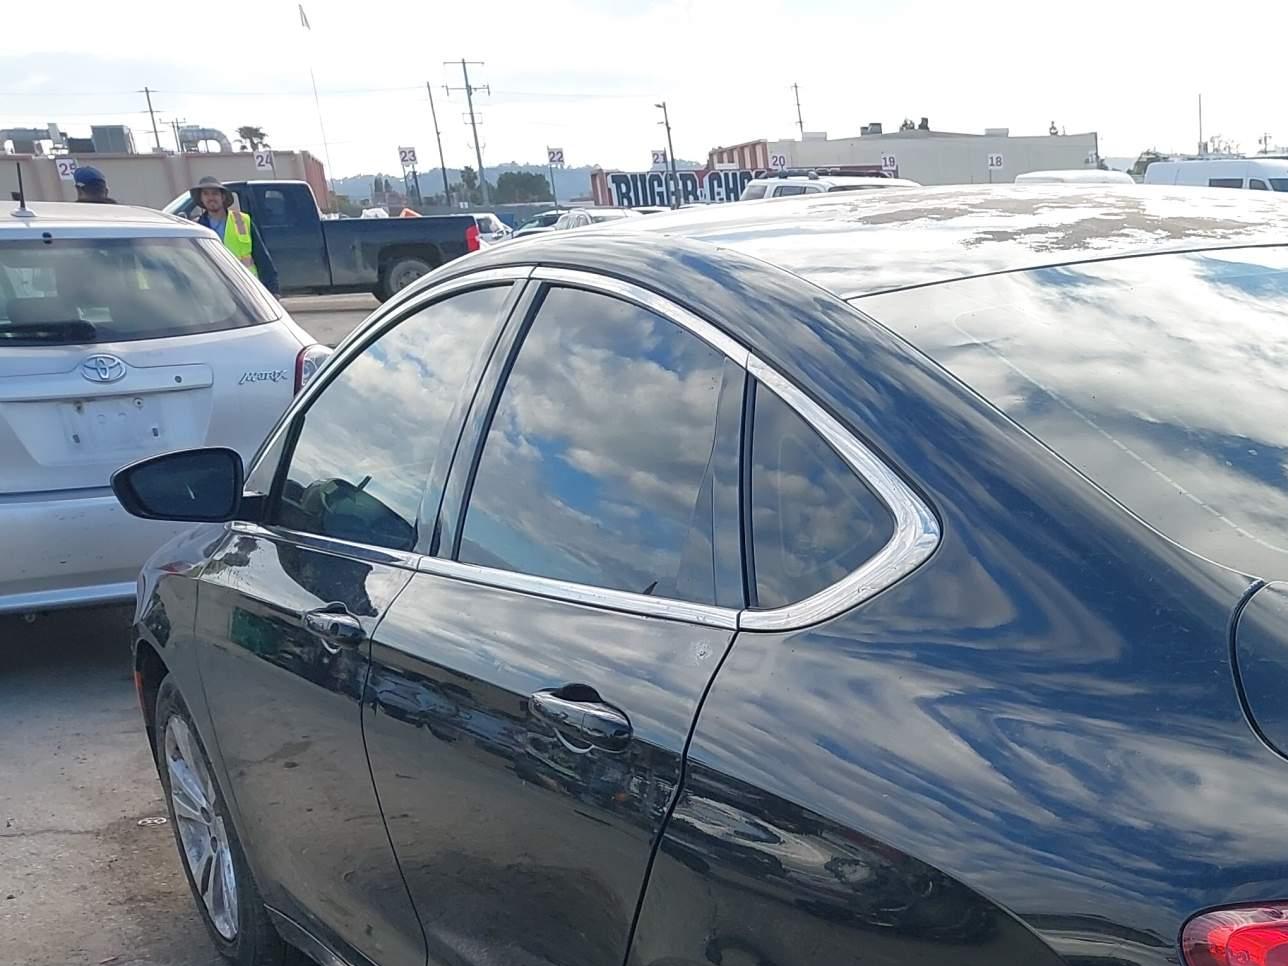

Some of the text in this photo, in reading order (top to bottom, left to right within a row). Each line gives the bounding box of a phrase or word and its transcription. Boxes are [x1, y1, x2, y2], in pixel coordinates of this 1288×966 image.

[256, 154, 273, 168] 24
[400, 151, 417, 163] 23
[549, 151, 564, 163] 22
[772, 155, 786, 167] 20
[882, 156, 896, 168] 19
[989, 156, 1002, 167] 18
